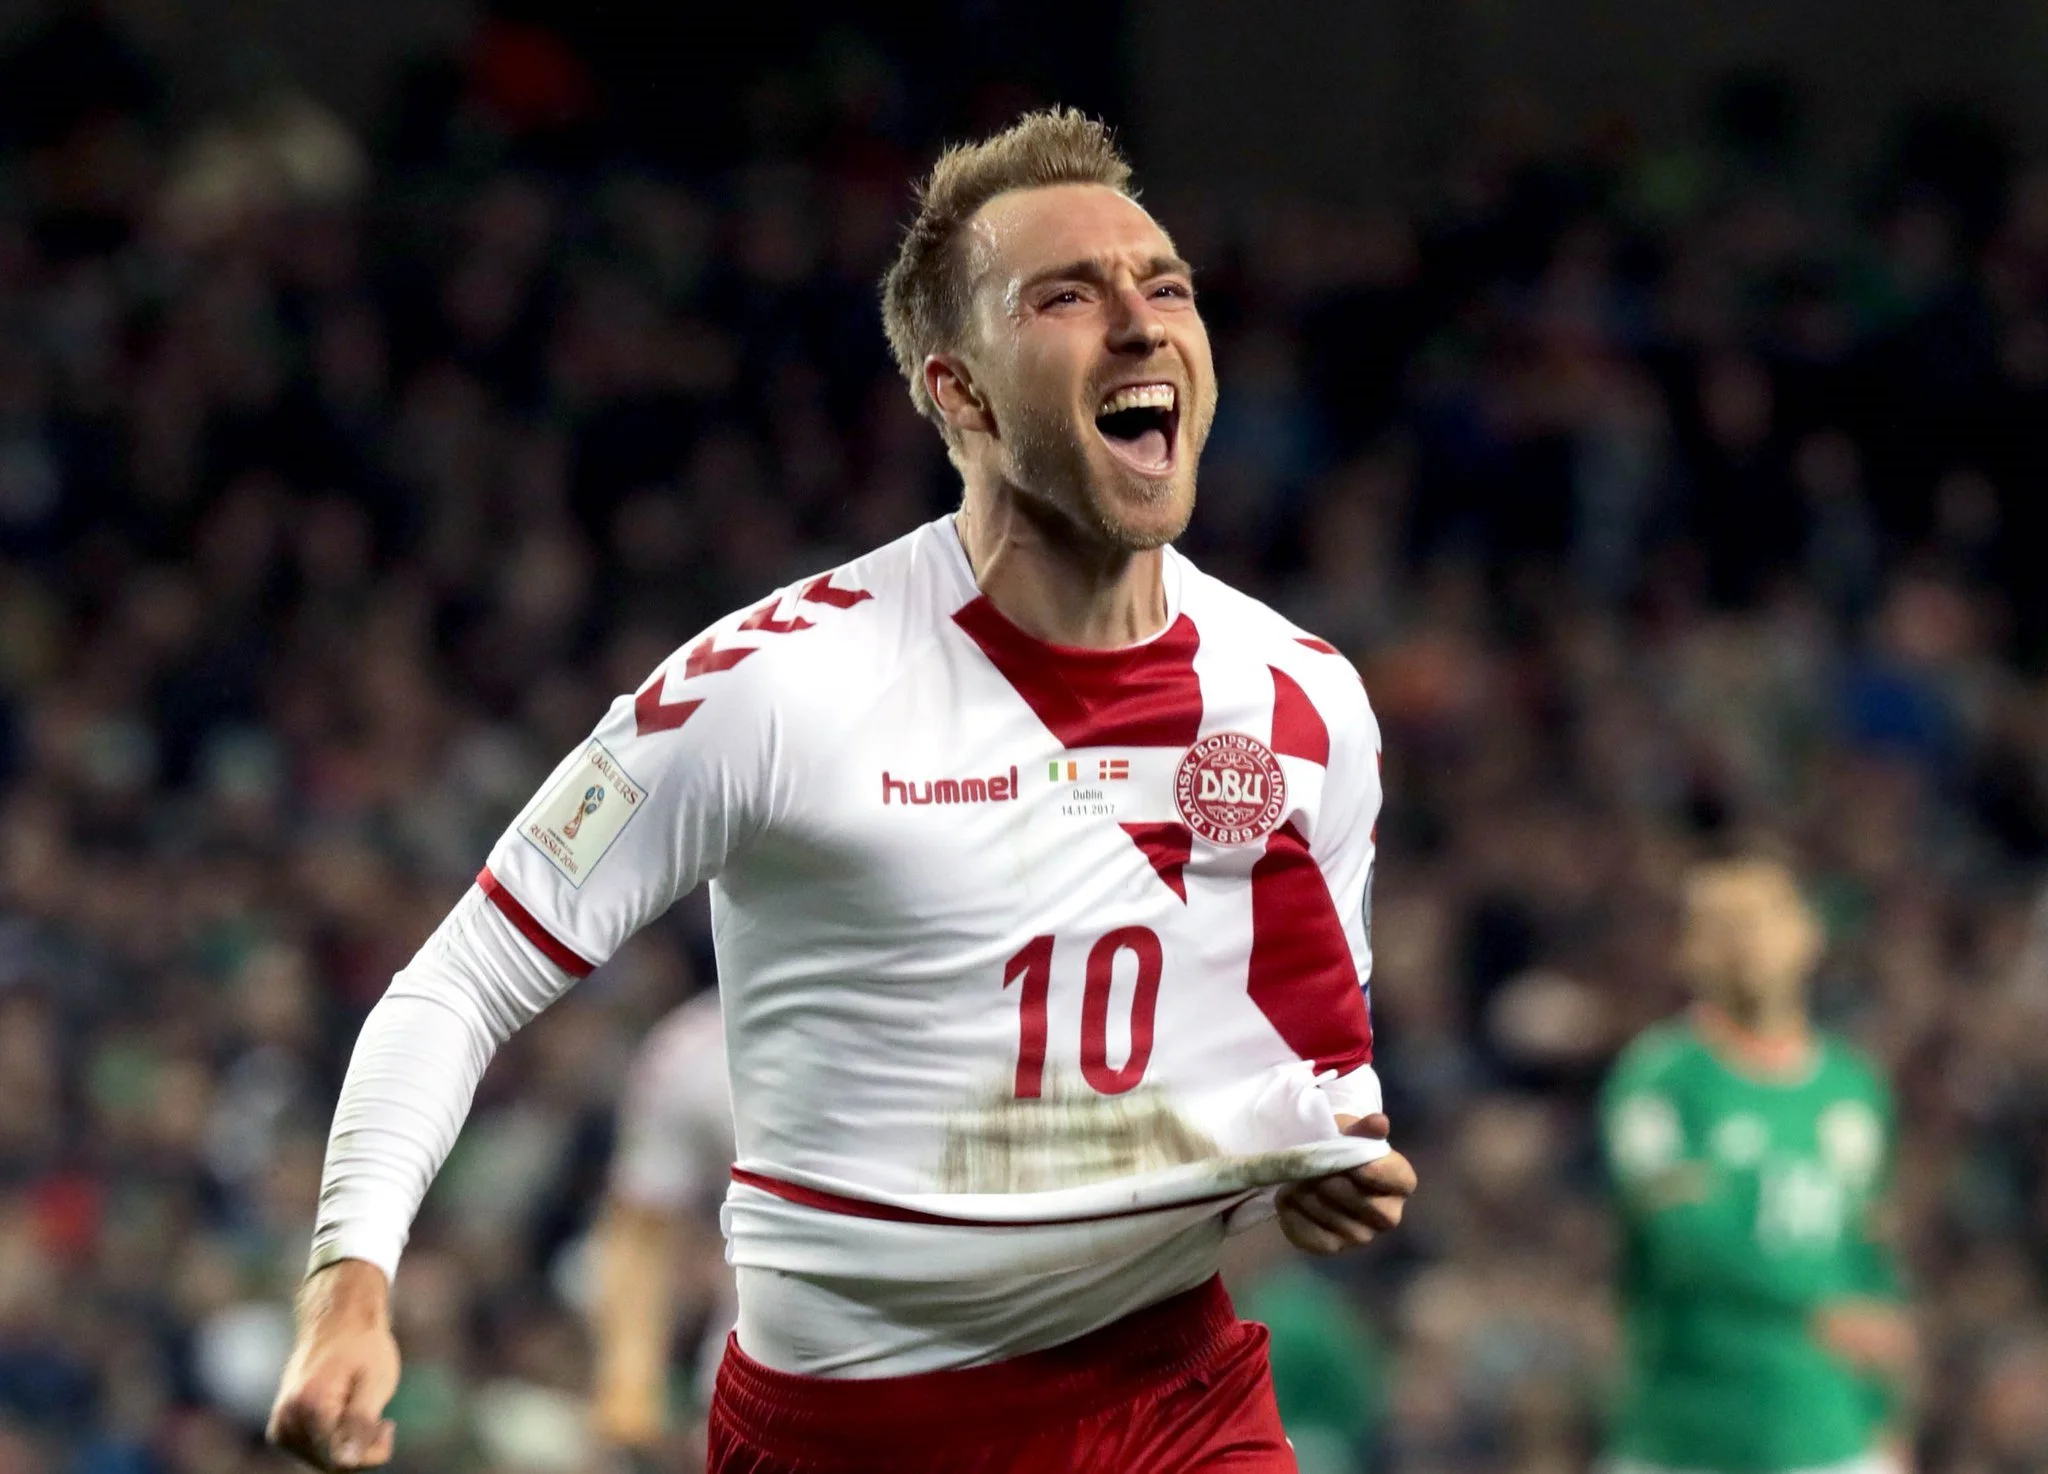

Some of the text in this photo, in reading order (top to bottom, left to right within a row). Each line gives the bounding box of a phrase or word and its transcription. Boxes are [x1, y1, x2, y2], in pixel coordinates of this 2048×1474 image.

[882, 764, 1018, 805] hummel
[1073, 788, 1104, 801] Dublin
[1198, 768, 1264, 805] DBU
[530, 823, 562, 858] RUSSIA
[1003, 925, 1163, 1098] 10
